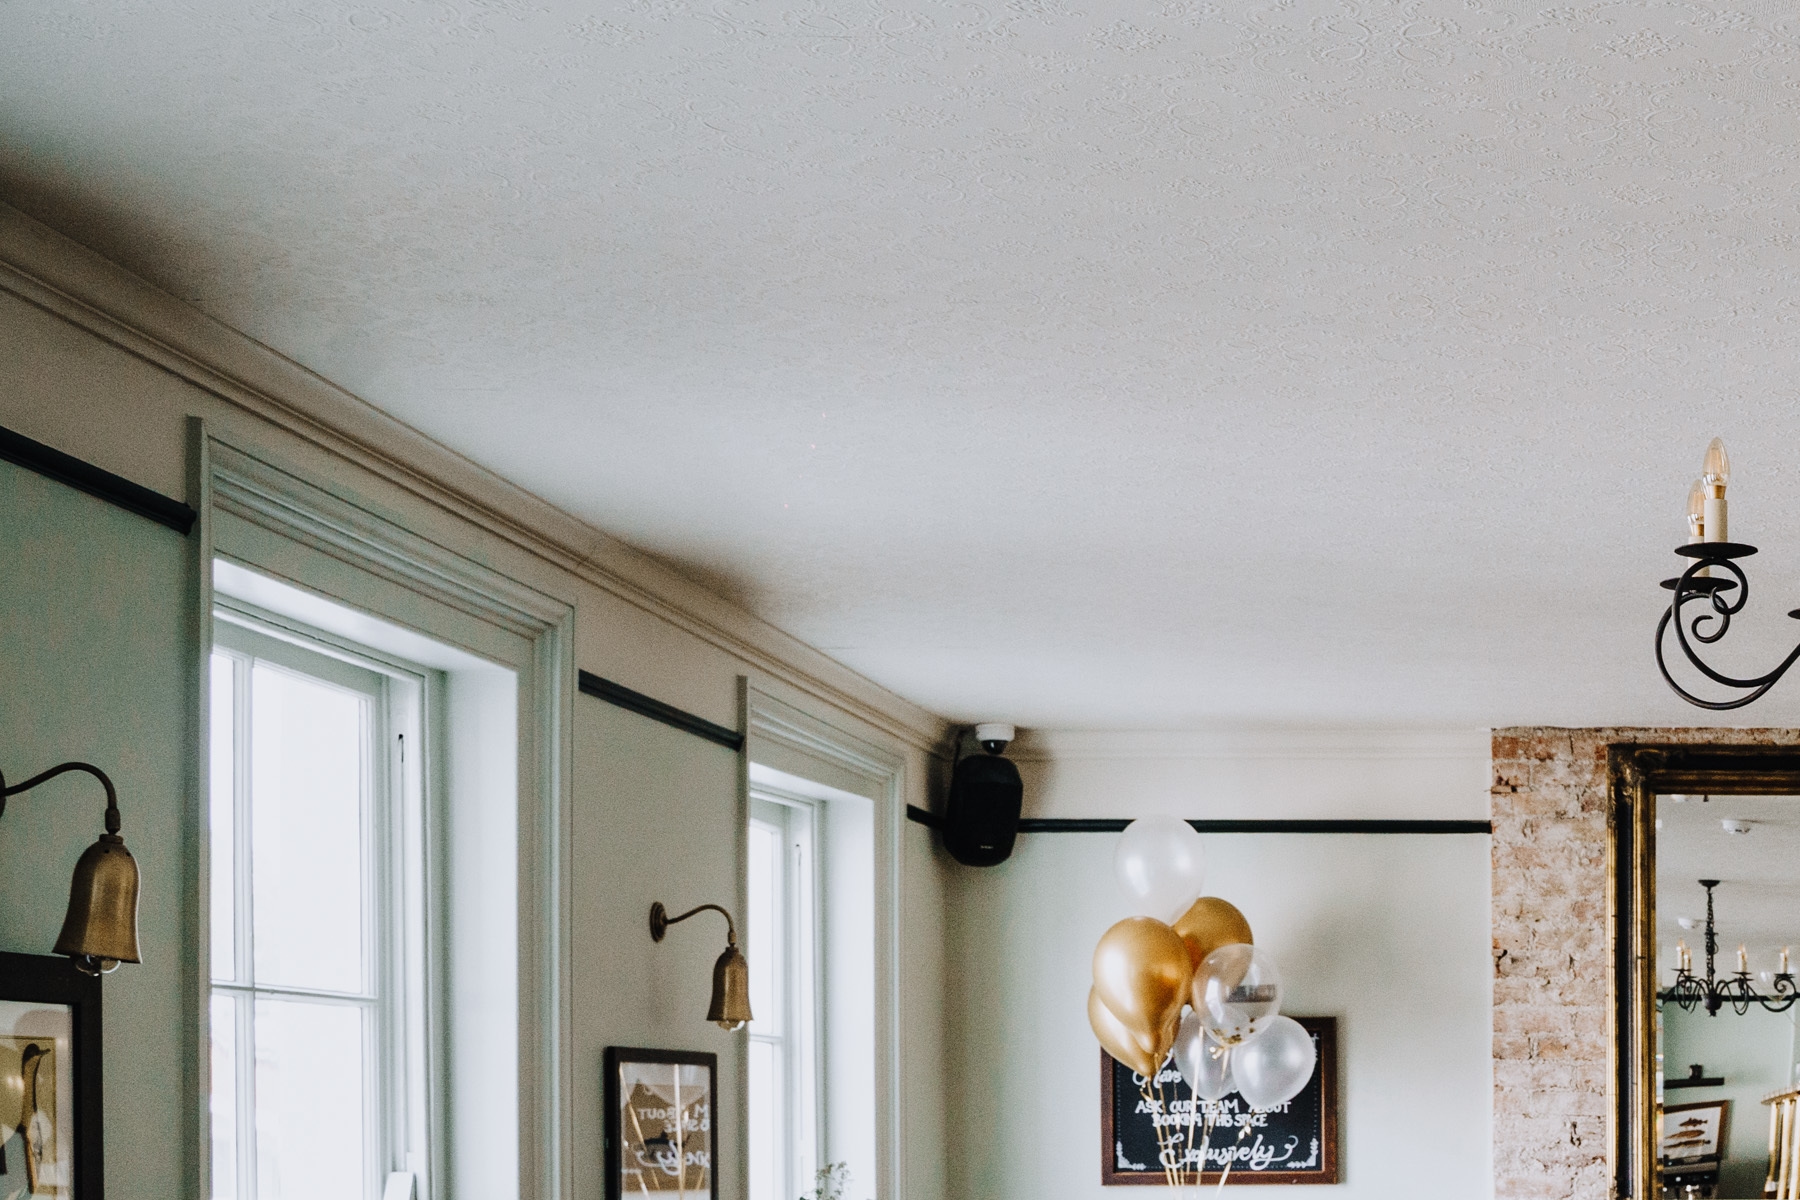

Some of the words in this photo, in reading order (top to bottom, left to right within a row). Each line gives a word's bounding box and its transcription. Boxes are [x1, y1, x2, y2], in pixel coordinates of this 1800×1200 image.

[1135, 1099, 1163, 1114] ASK
[1169, 1099, 1194, 1114] OUR
[1197, 1098, 1239, 1114] TEAM
